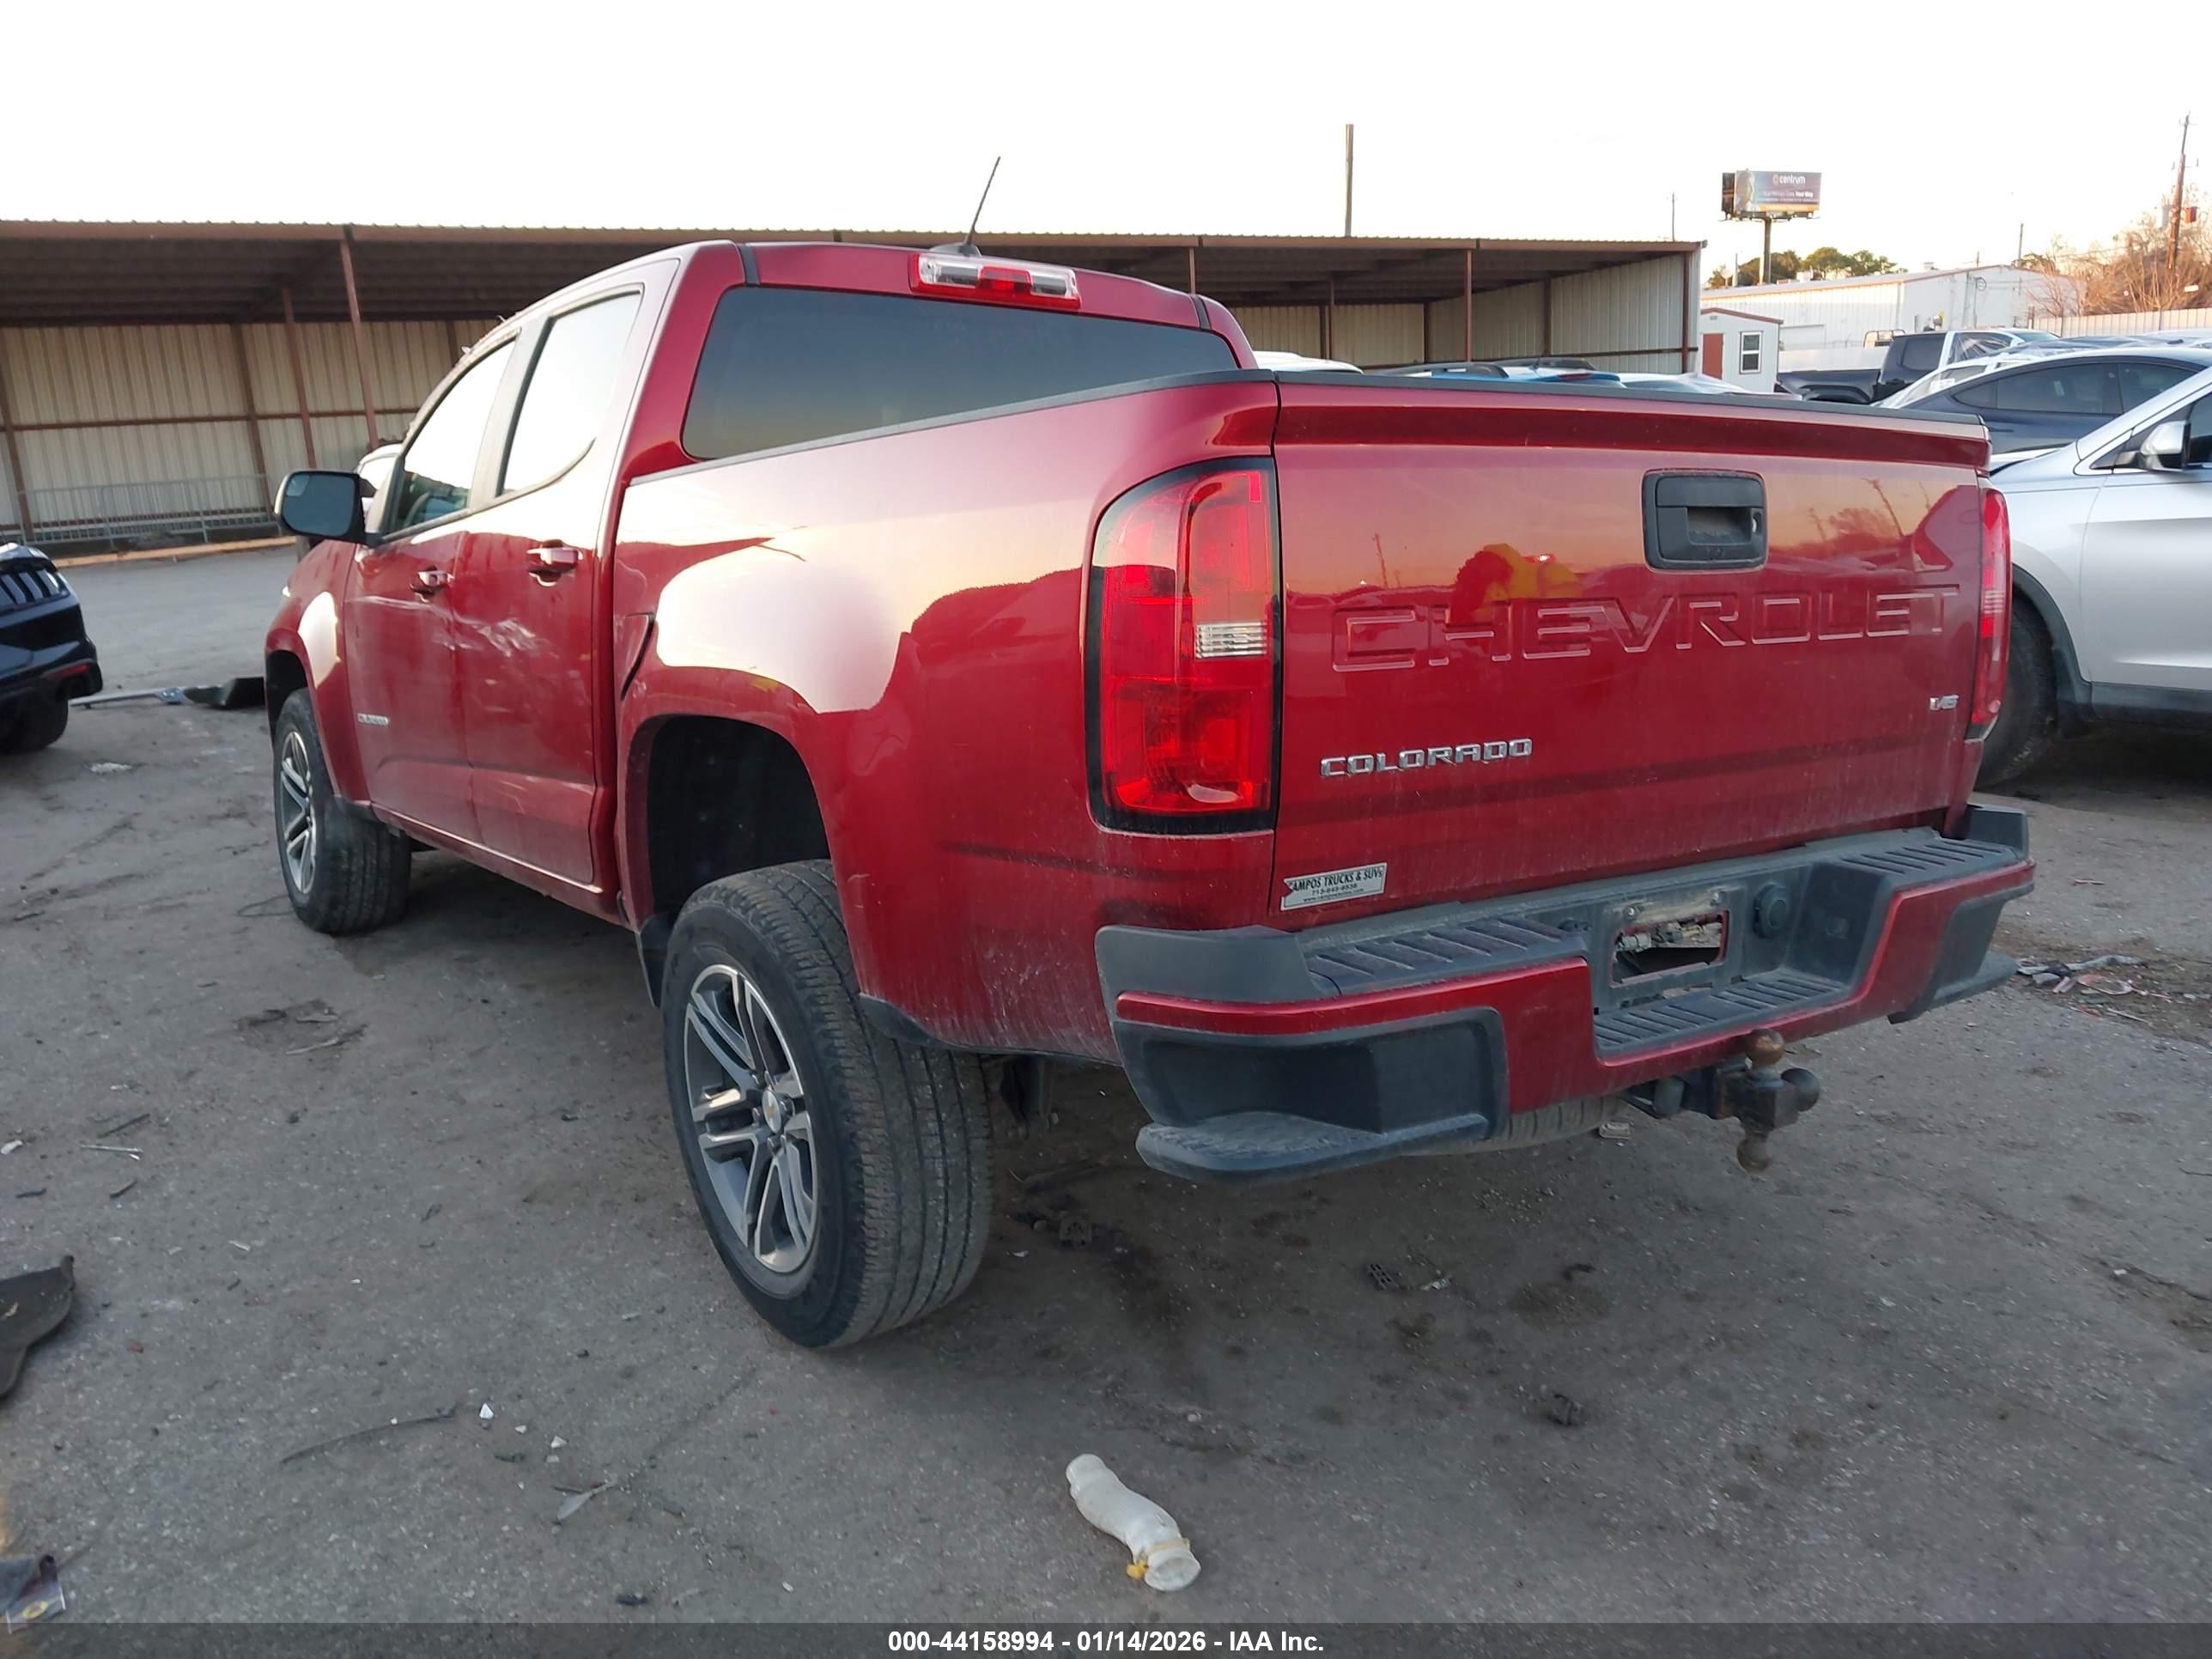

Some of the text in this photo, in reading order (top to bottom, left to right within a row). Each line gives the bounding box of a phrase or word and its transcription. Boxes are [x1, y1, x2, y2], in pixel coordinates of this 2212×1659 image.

[1778, 174, 1806, 185] centrum
[1333, 584, 1960, 672] CHEVROLET
[1930, 695, 1959, 710] V6
[1321, 738, 1533, 776] COLORADO
[1324, 872, 1354, 886] TRUCKS
